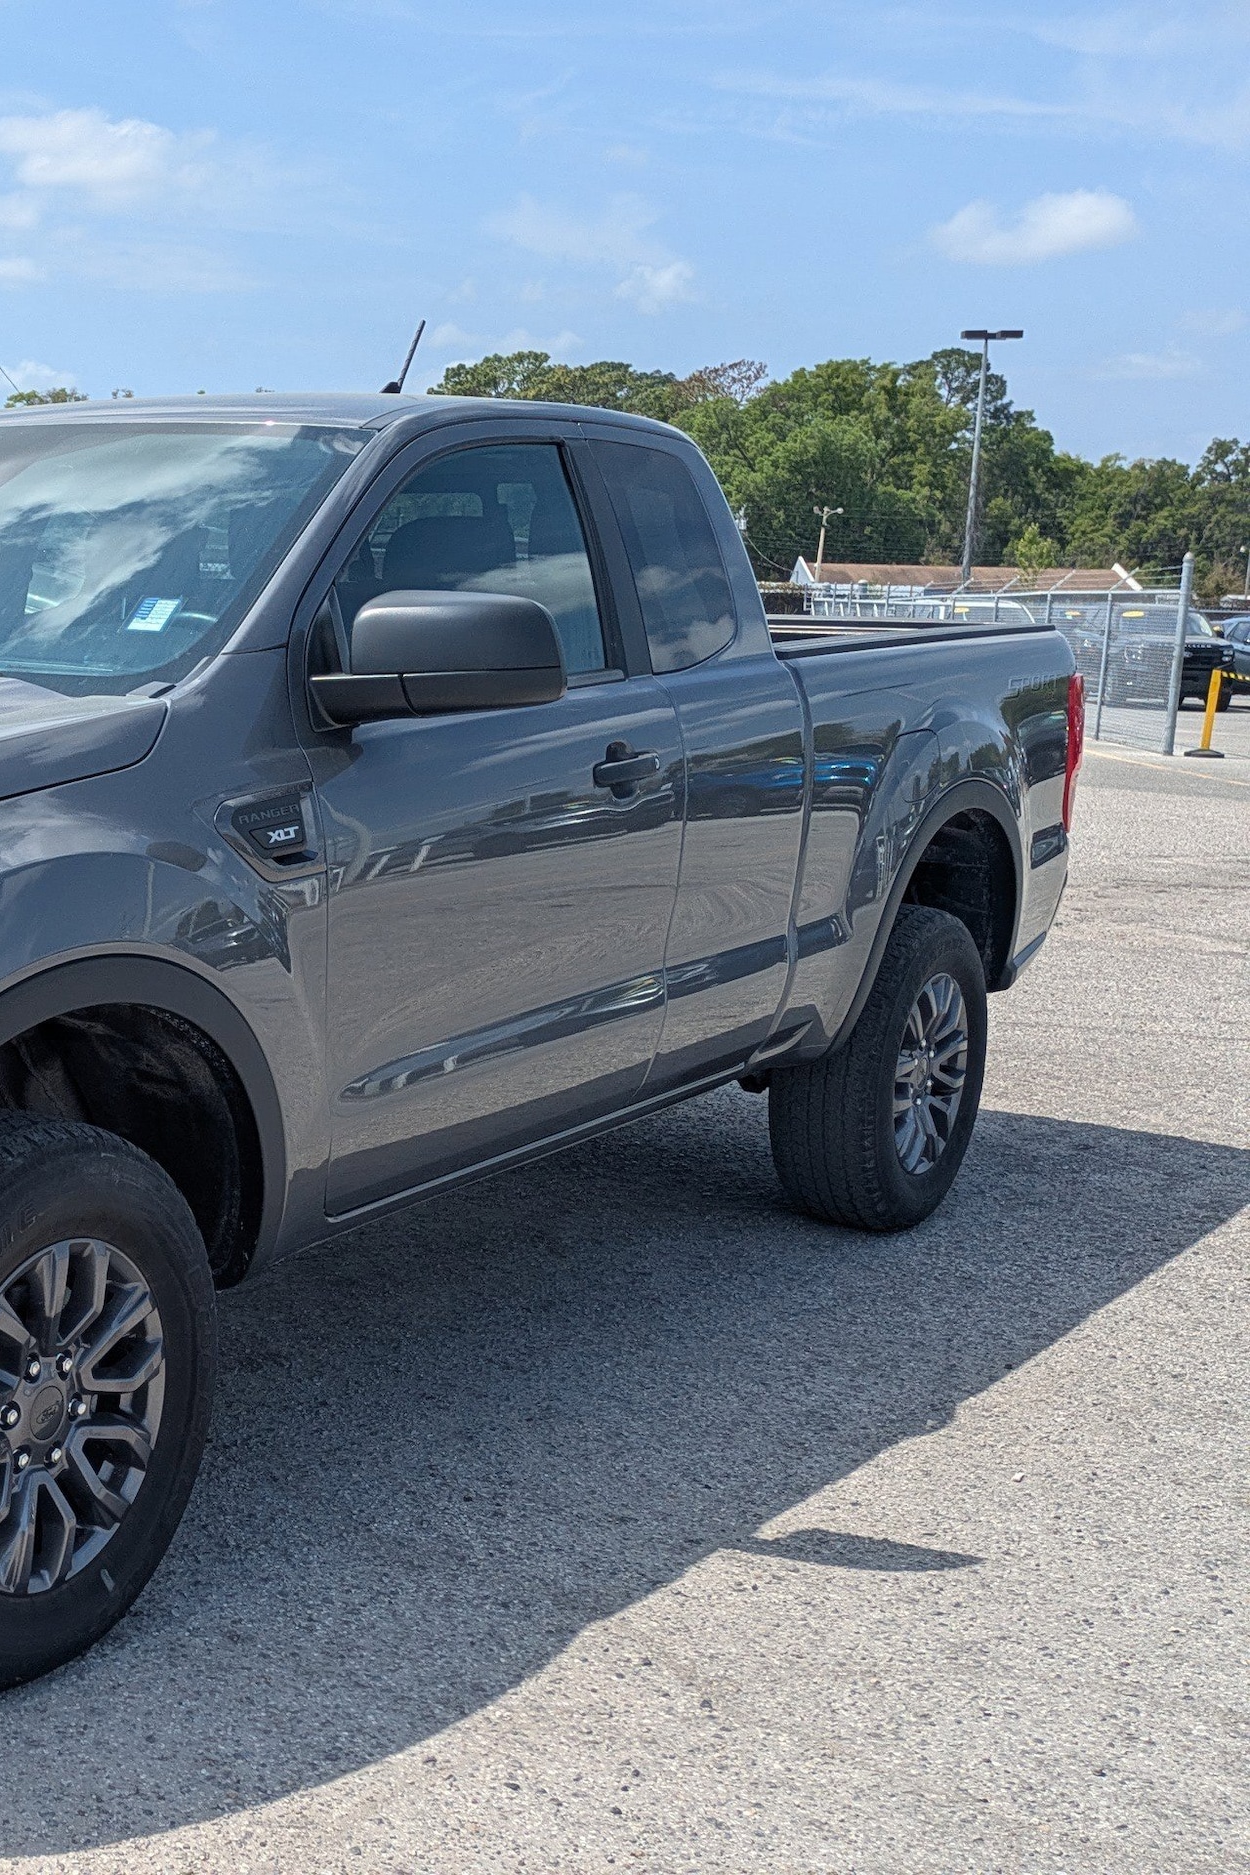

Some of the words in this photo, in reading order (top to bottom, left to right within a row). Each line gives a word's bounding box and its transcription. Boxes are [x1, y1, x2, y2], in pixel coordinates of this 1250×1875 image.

[1004, 674, 1060, 699] SPORT
[238, 804, 300, 824] RANGER
[267, 826, 299, 844] XLT
